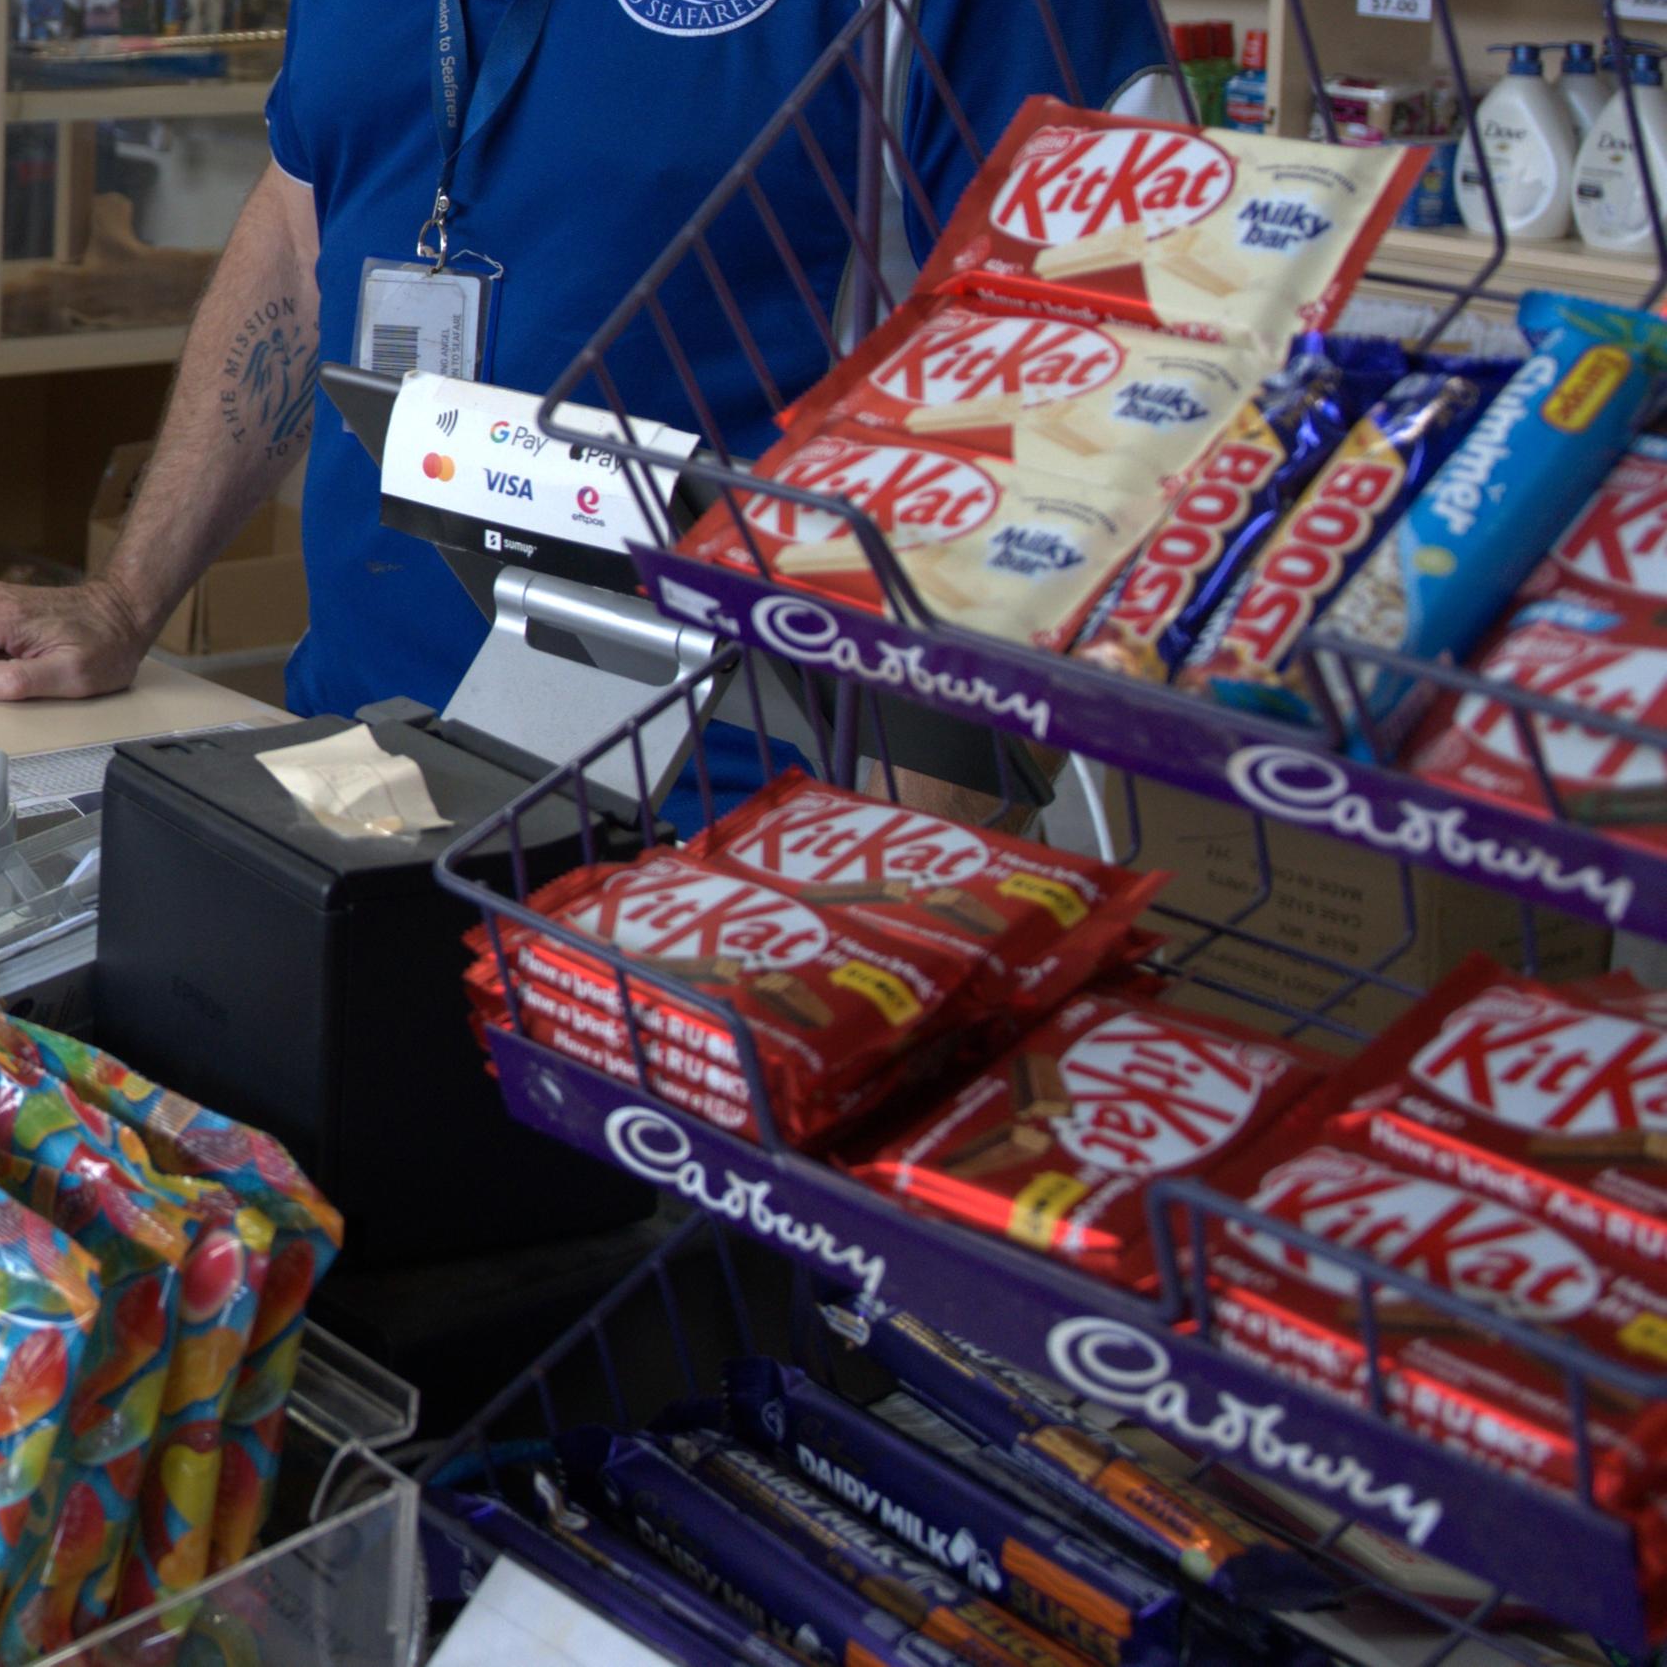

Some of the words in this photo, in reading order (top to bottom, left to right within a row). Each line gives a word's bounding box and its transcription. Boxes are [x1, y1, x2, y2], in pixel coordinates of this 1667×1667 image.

[439, 36, 452, 51] to
[440, 55, 459, 129] Seafarers
[1483, 122, 1528, 141] Dove
[999, 131, 1224, 243] KitKat
[1238, 199, 1332, 241] Milky
[1242, 224, 1299, 250] bar
[224, 297, 296, 378] MISSION
[875, 319, 1110, 404] KitKat
[221, 391, 246, 444] THE
[1115, 403, 1176, 426] bar
[1117, 381, 1209, 422] Milky
[264, 442, 289, 461] TO
[512, 426, 550, 458] Pay
[584, 443, 624, 475] Pay
[1430, 354, 1557, 533] Summer
[483, 467, 535, 502] VISA
[571, 513, 606, 529] eftpos
[503, 536, 535, 557] sumup
[988, 551, 1051, 577] bar
[991, 526, 1087, 568] Milky
[1126, 440, 1274, 637] BOOST
[1232, 461, 1396, 665] BOOST
[751, 594, 1051, 741] Cadbury
[736, 798, 984, 883] KitKat
[1227, 746, 1636, 924] Cadbury
[573, 866, 822, 960] KitKat
[1067, 1013, 1257, 1173] KitKat
[604, 1106, 887, 1299] Cadbury
[1370, 1120, 1433, 1164] Have
[1545, 1192, 1601, 1231] Ask
[1046, 1315, 1443, 1548] Cadbury
[724, 1448, 823, 1523] DAIRY
[819, 1500, 908, 1578] MILK
[798, 1443, 881, 1515] DAIRY
[877, 1497, 952, 1564] MILK
